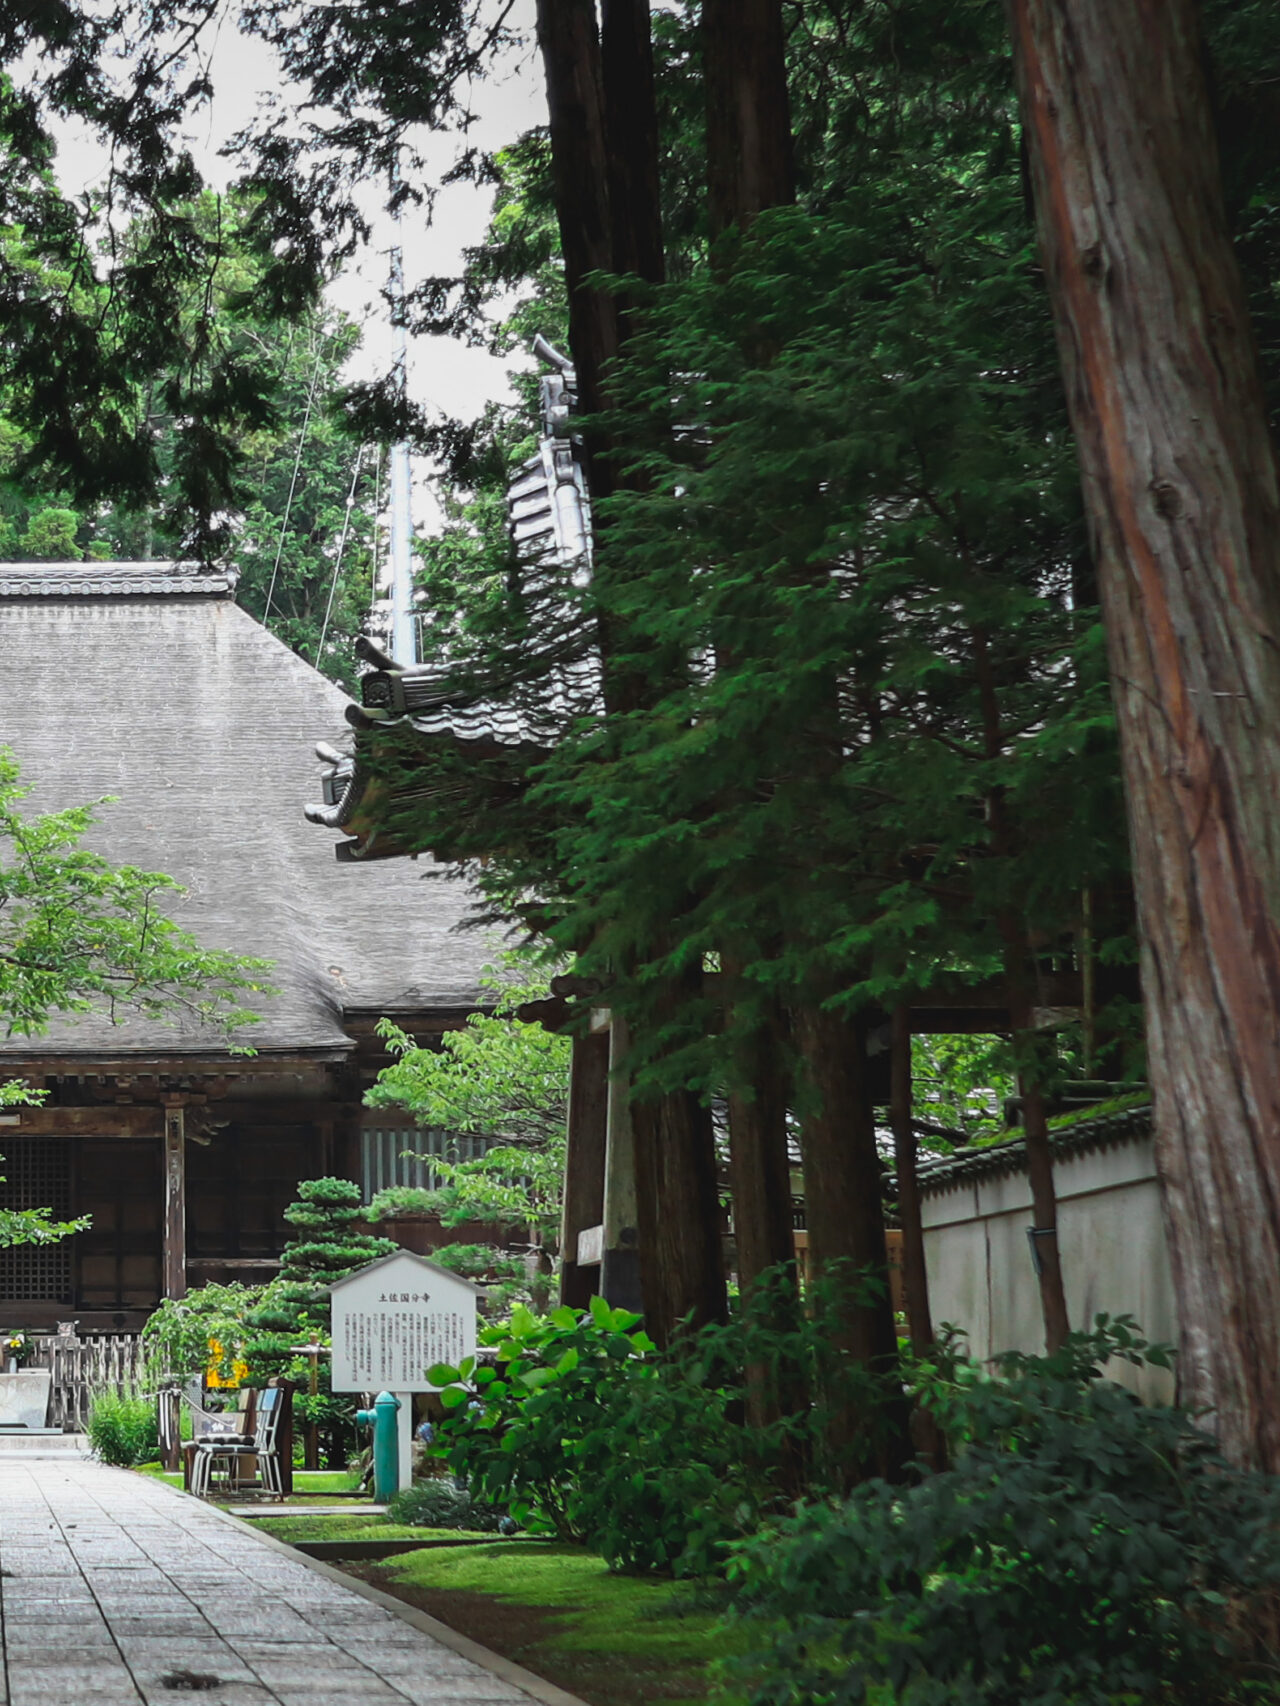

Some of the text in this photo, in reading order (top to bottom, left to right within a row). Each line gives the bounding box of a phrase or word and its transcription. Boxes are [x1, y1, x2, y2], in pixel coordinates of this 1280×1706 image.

[378, 1292, 431, 1303] 土佐国分寺
